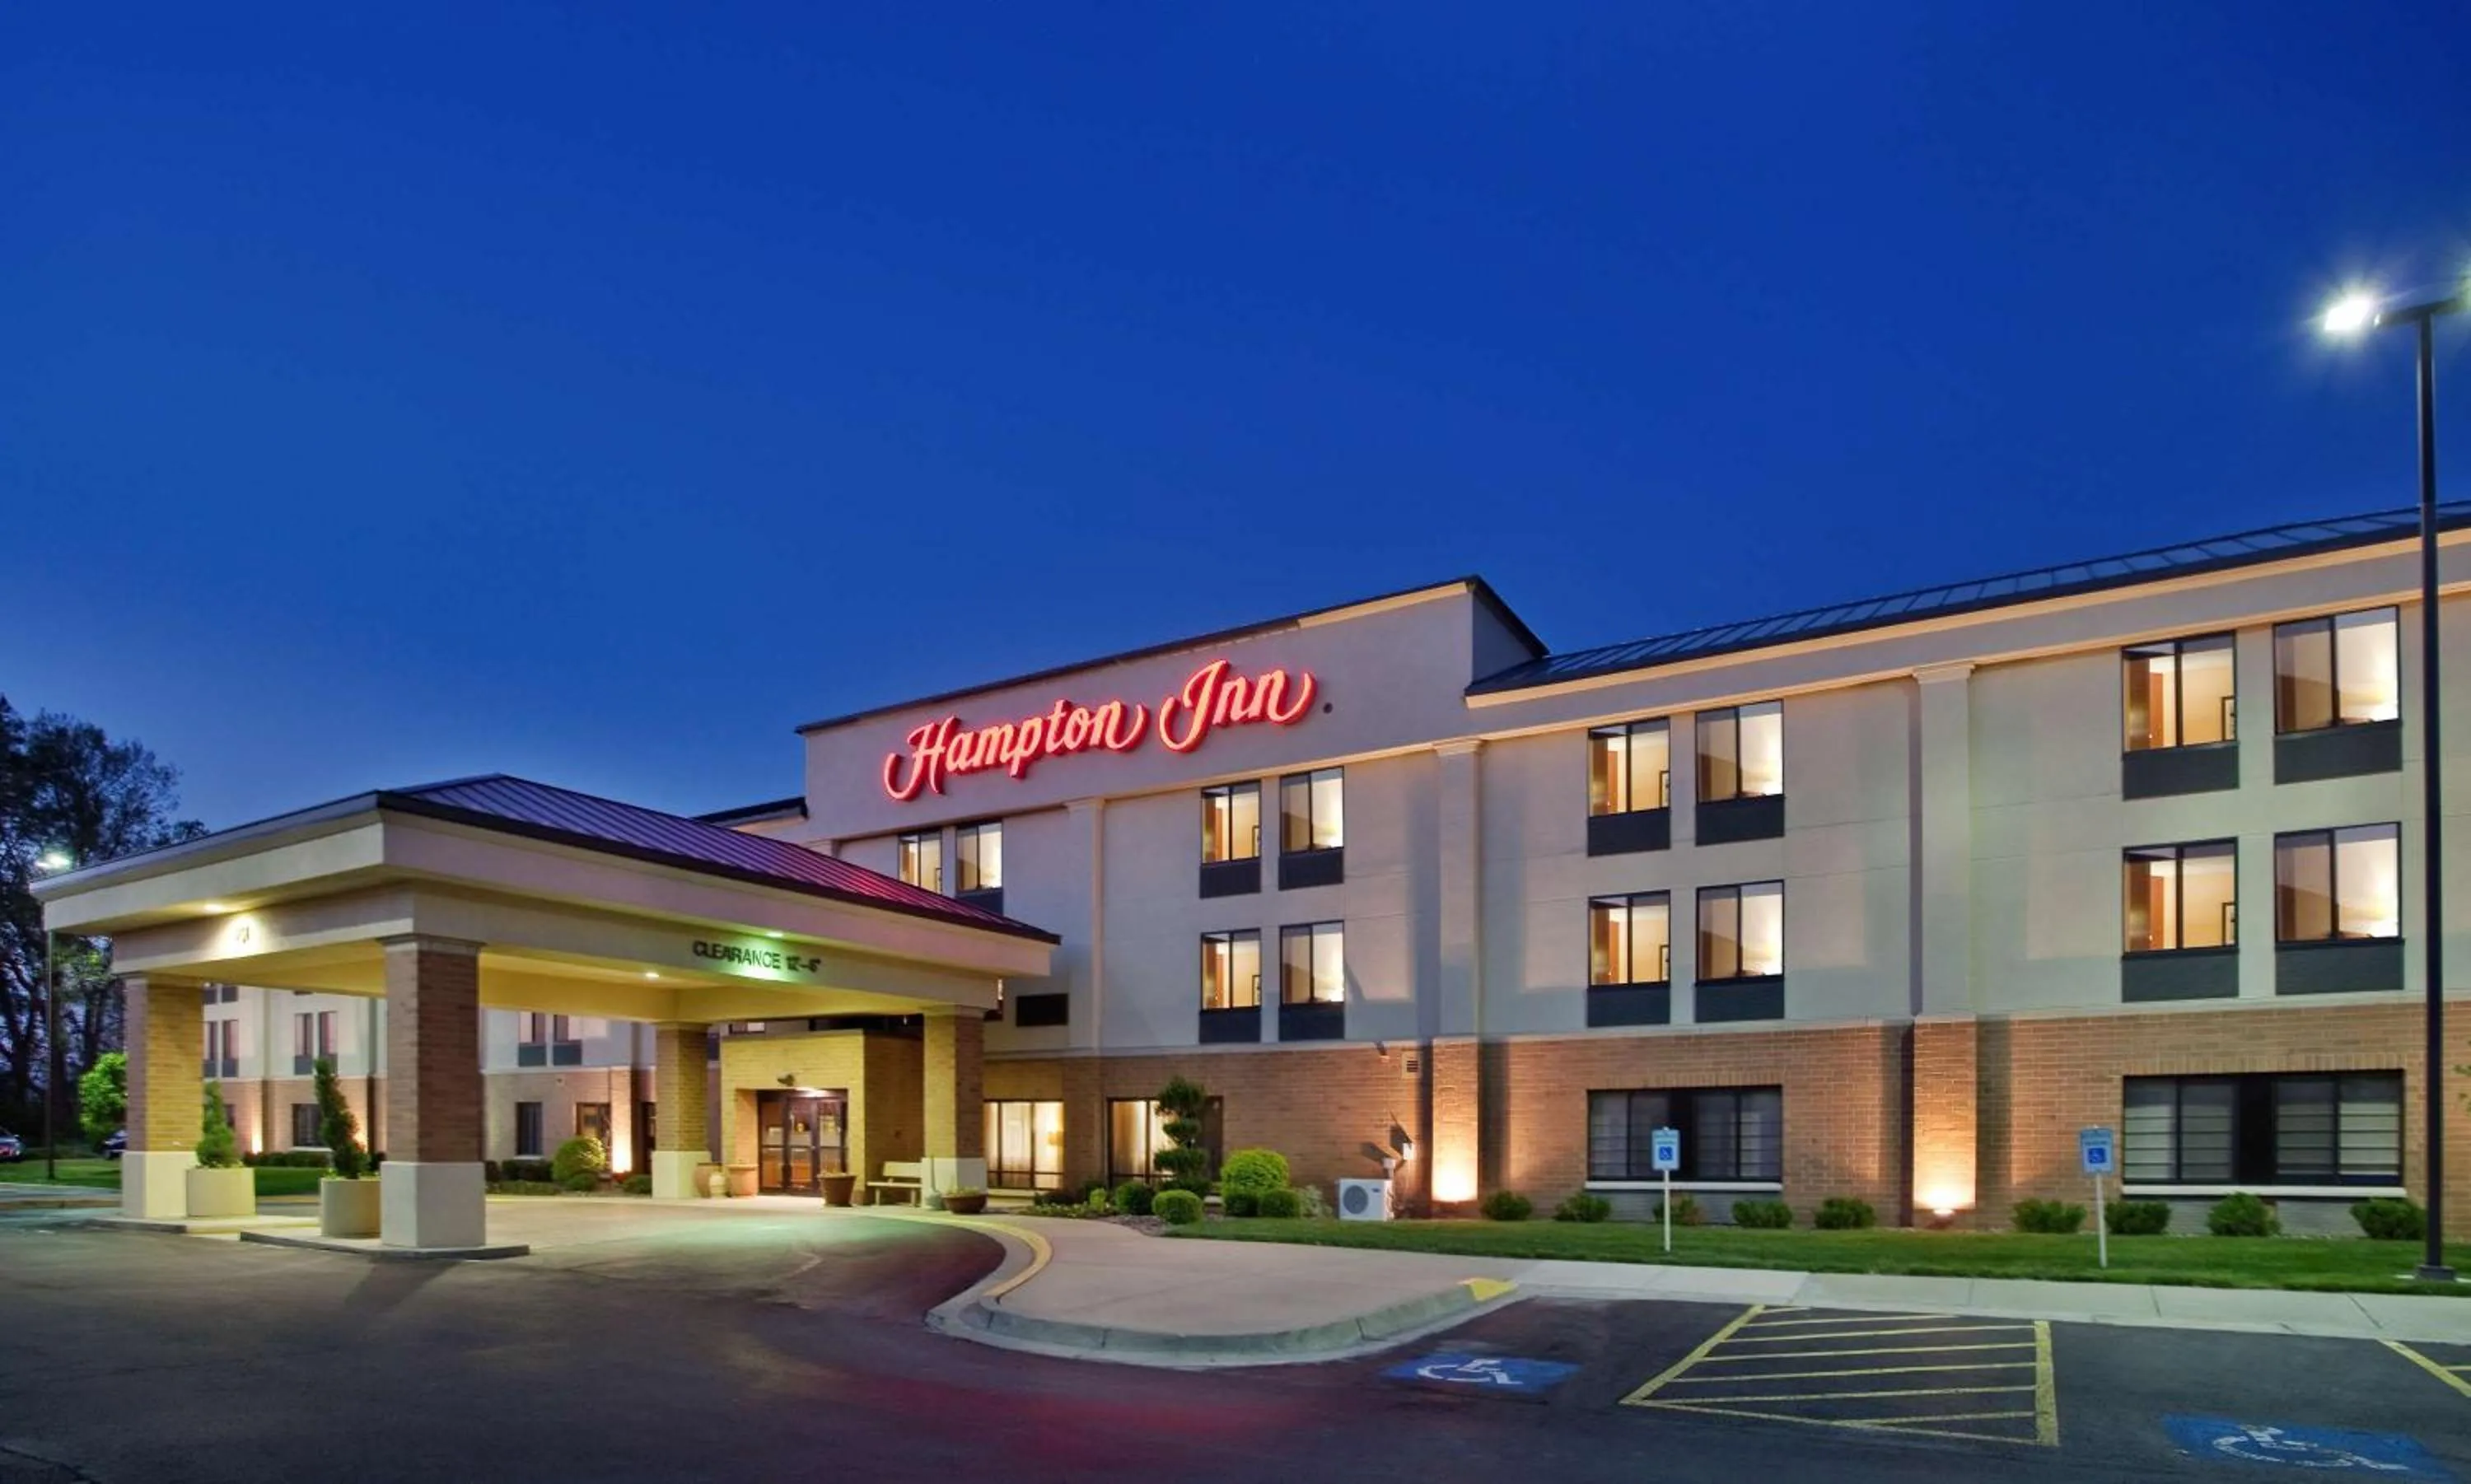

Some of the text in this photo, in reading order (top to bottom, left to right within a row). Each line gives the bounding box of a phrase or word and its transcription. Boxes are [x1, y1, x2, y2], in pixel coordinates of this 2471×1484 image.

[883, 659, 1316, 800] Hampton Inn
[693, 940, 782, 969] CLEARANCE
